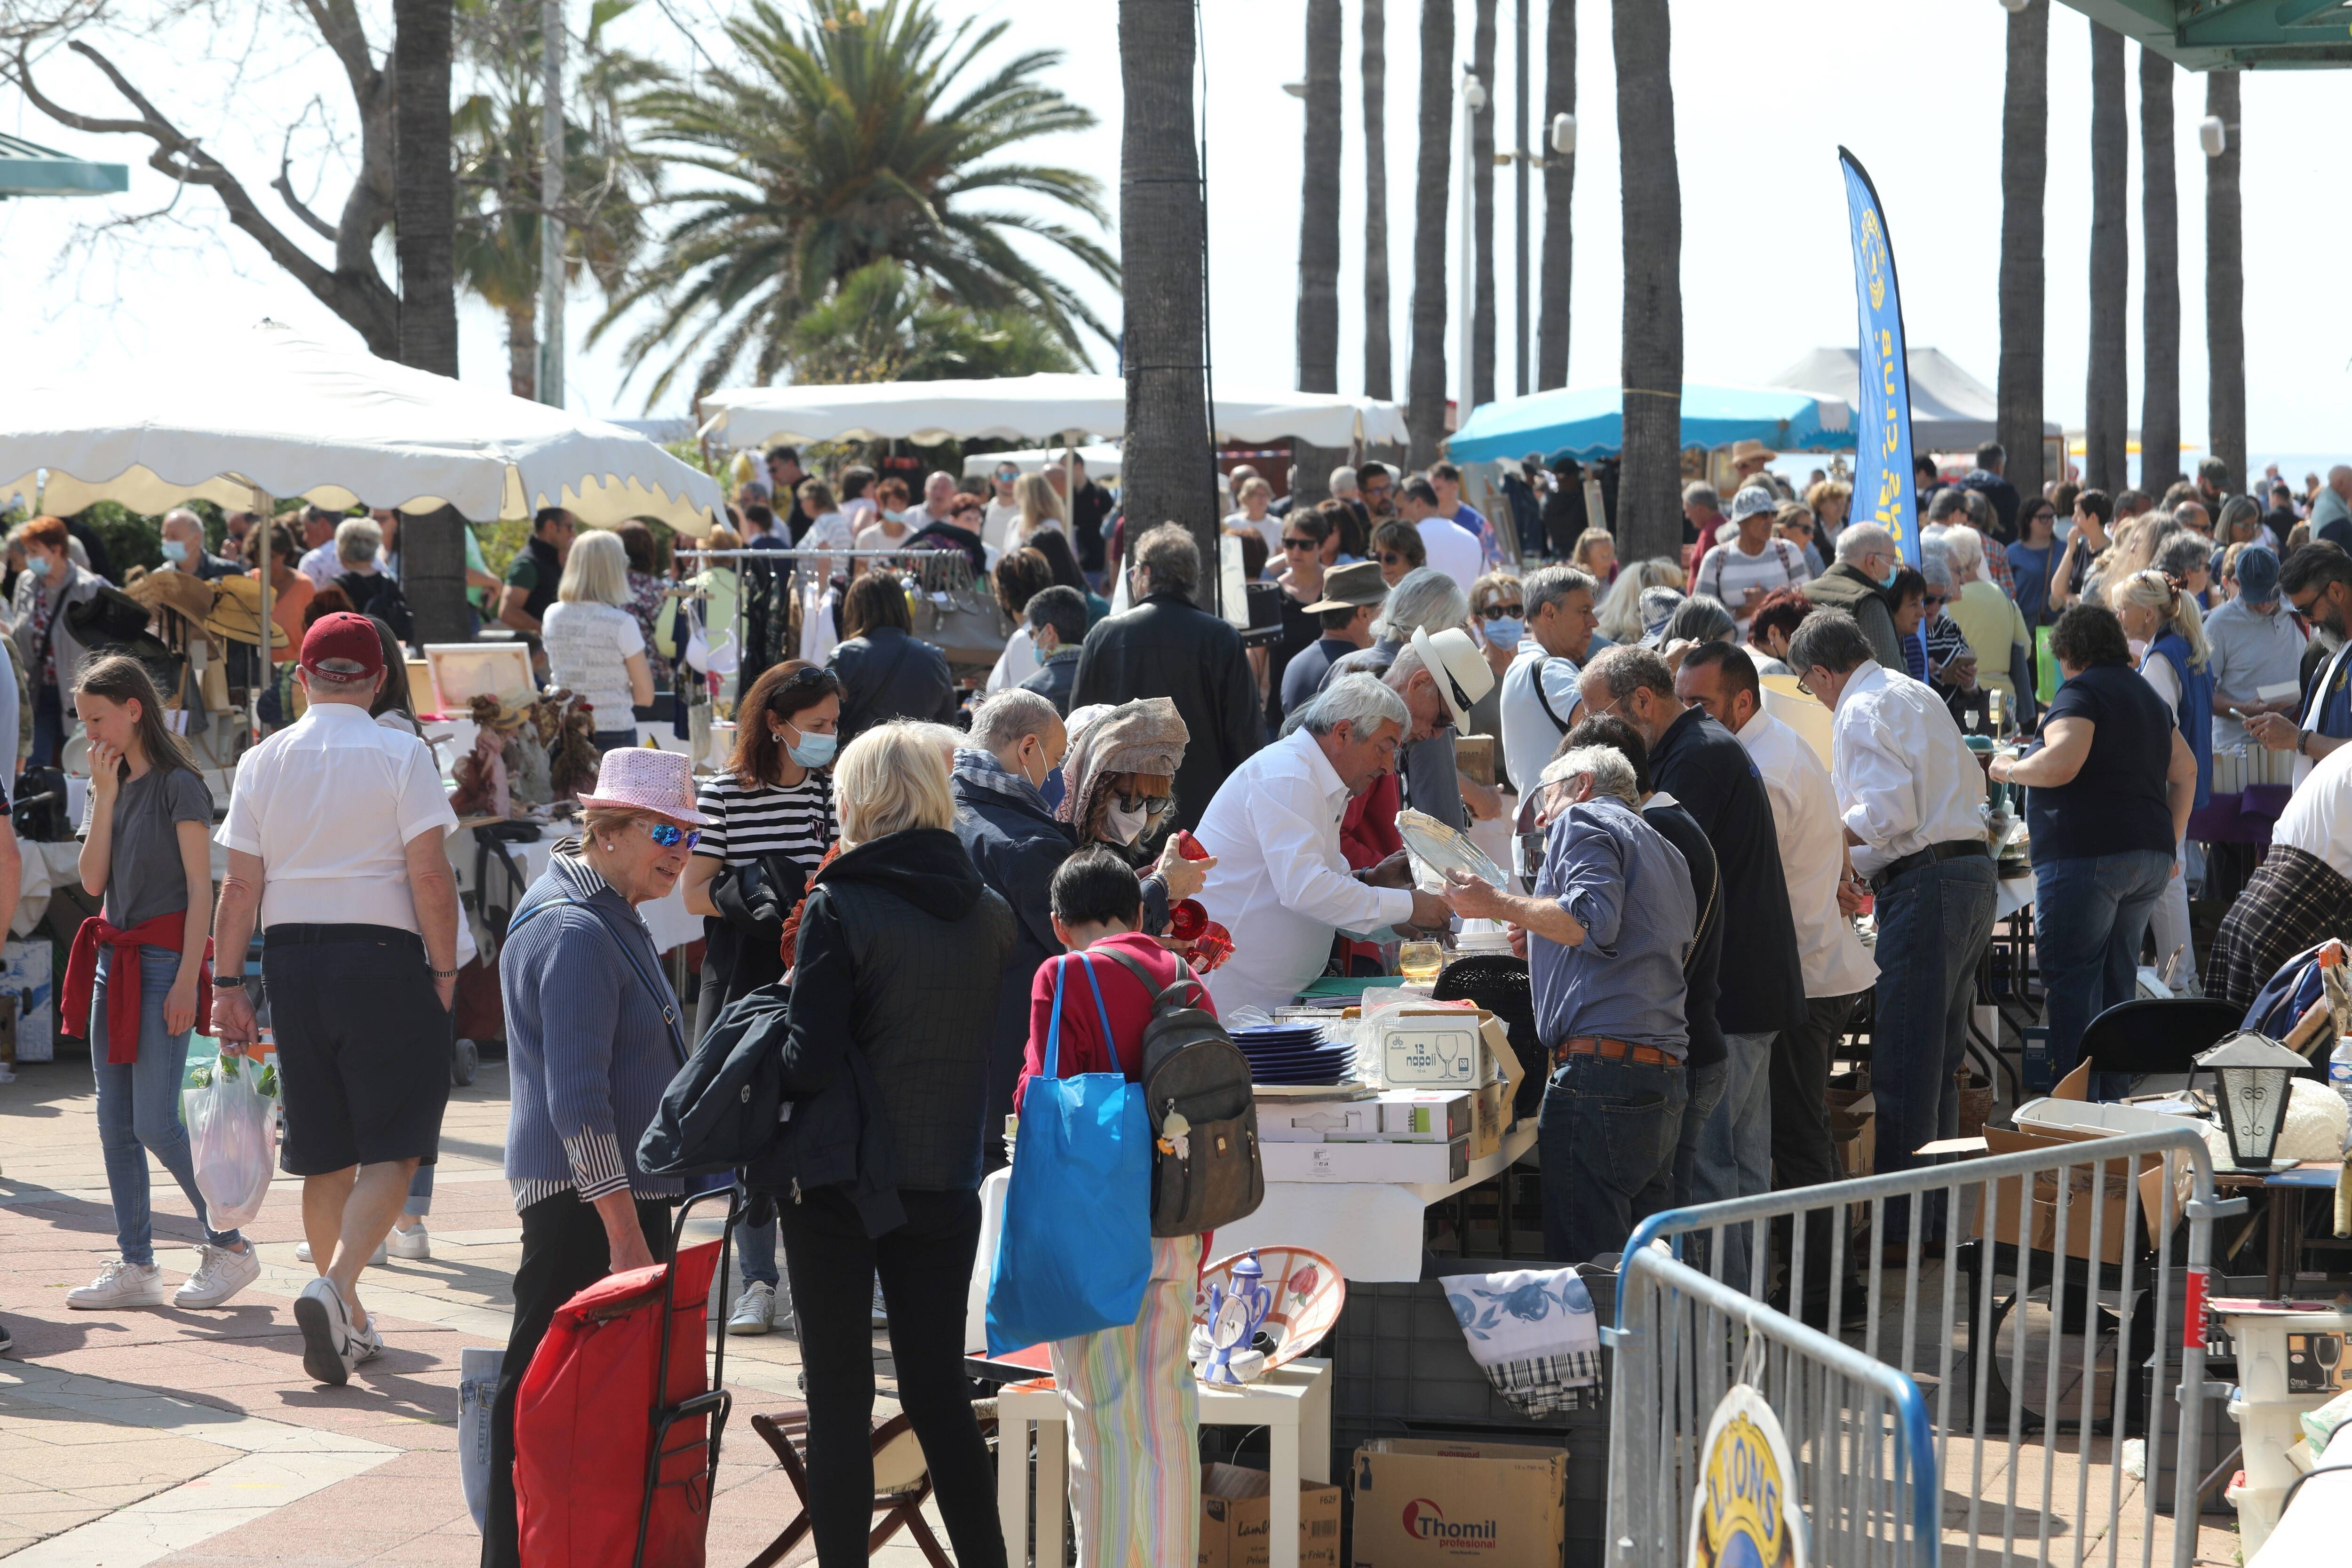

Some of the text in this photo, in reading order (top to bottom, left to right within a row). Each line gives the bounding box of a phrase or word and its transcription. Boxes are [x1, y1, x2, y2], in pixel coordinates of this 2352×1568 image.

[317, 669, 346, 681] COCKS
[1415, 1044, 1424, 1054] 12
[1406, 1053, 1436, 1068] napoli
[2290, 1377, 2307, 1386] Onyx
[1710, 1436, 1776, 1541] LIONS
[1320, 1495, 1337, 1504] F62F
[1418, 1517, 1496, 1538] Thomil
[1439, 1539, 1495, 1548] profesional
[1247, 1554, 1270, 1566] Privat
[1308, 1550, 1326, 1560] Fries
